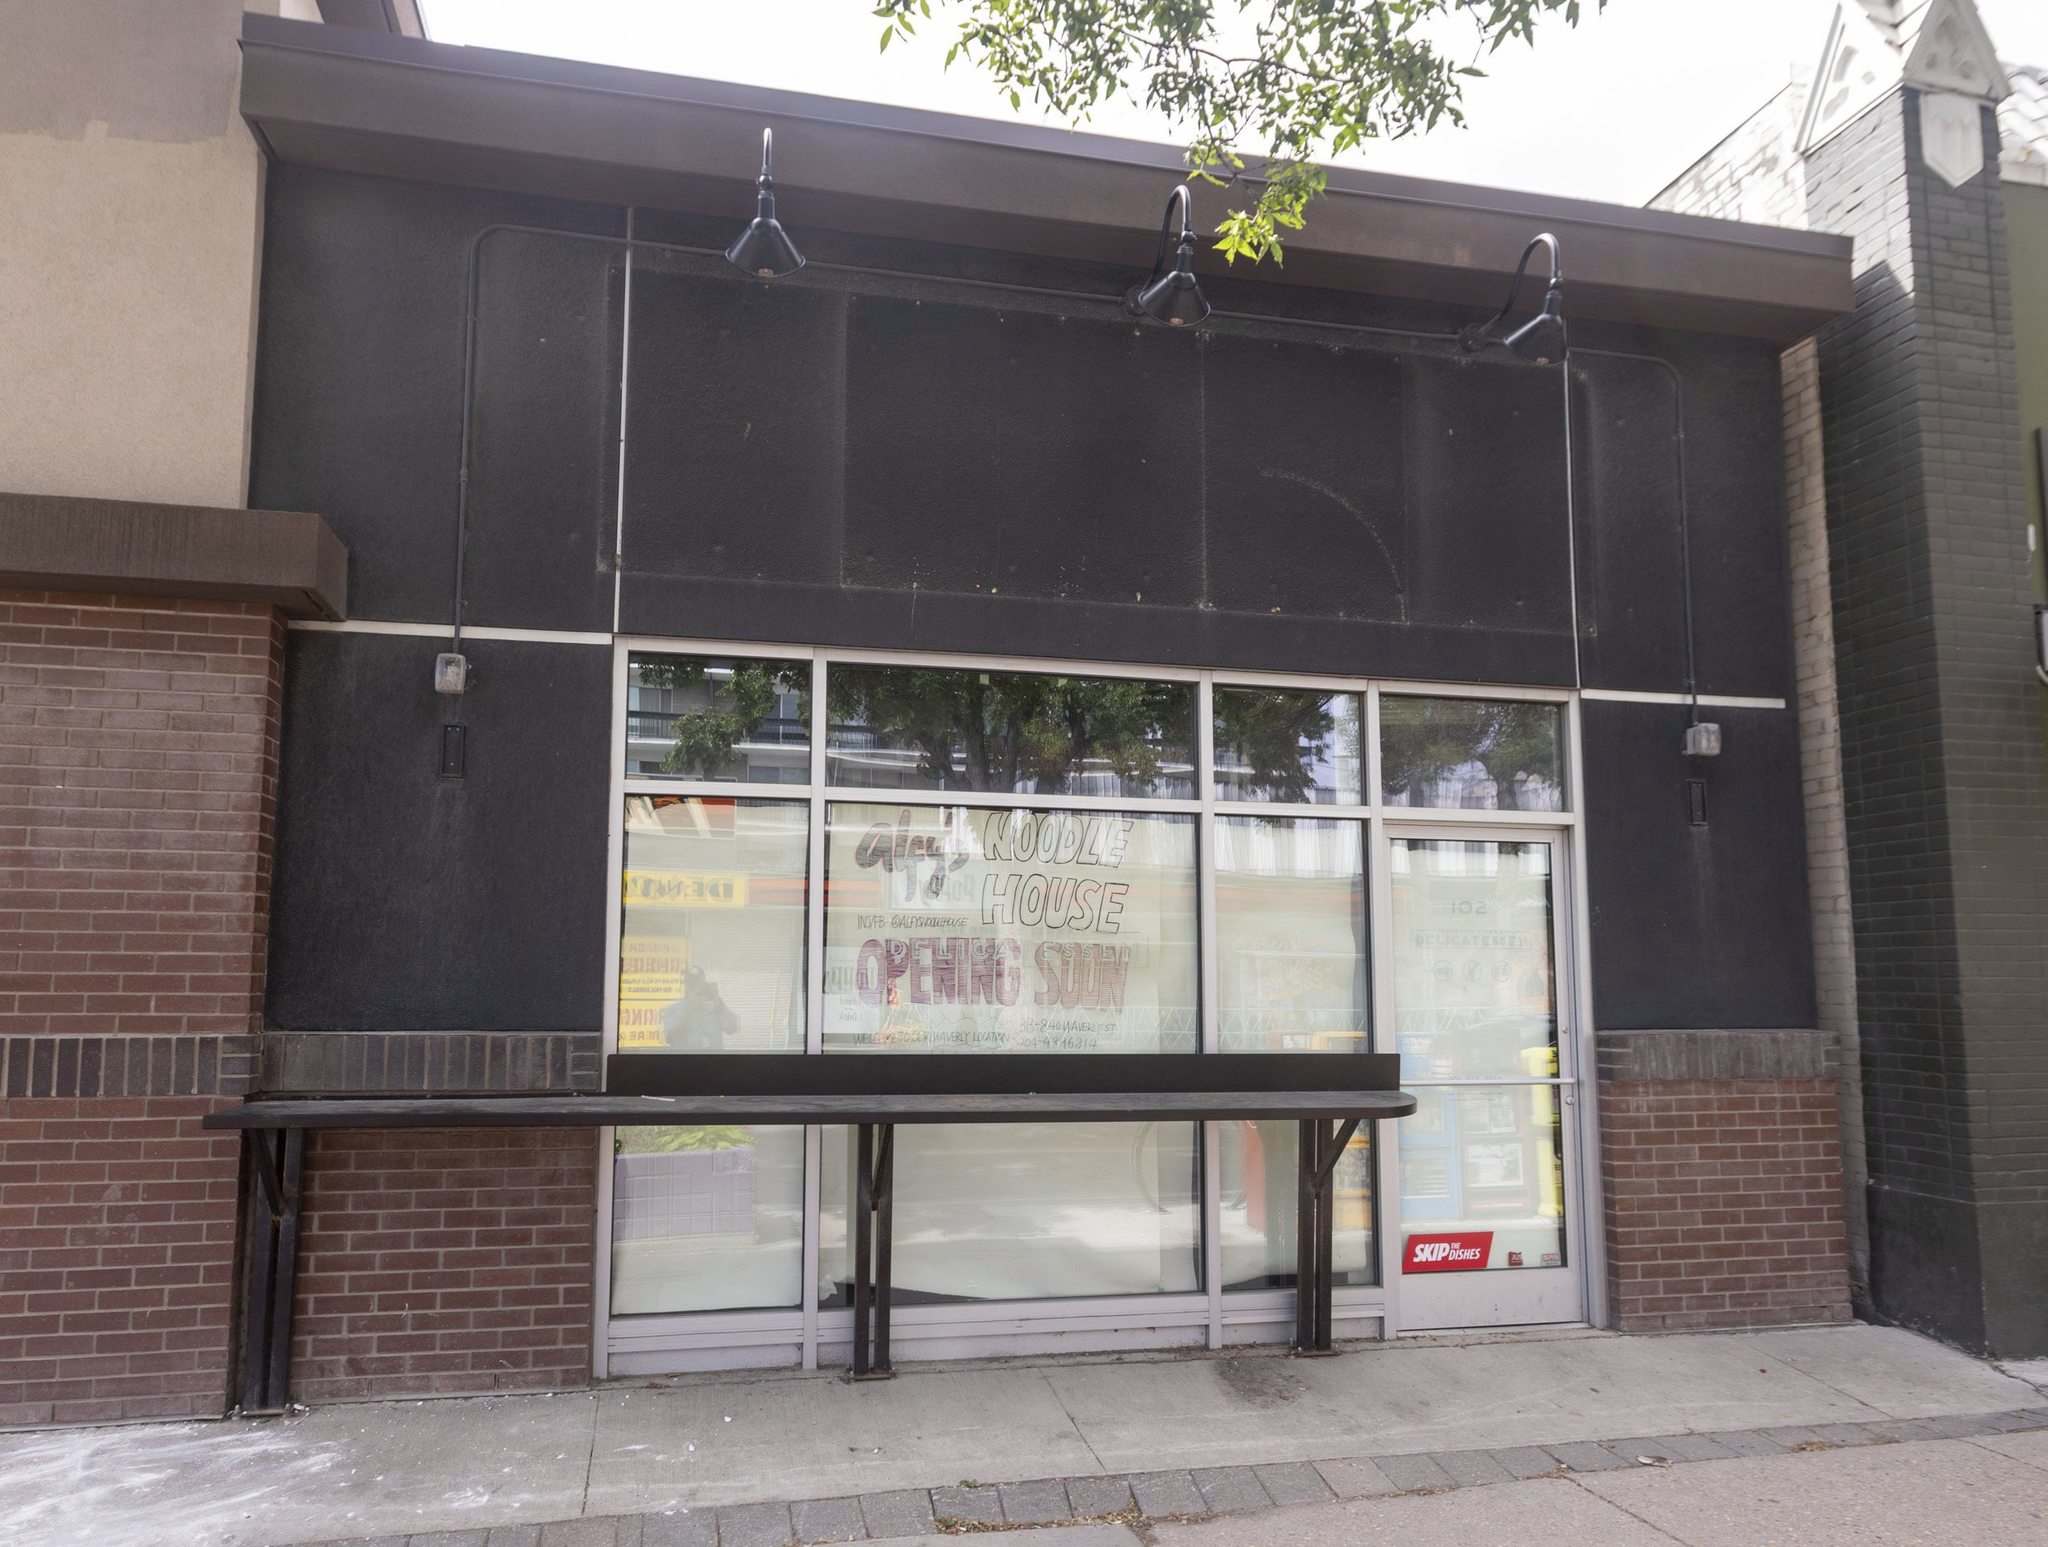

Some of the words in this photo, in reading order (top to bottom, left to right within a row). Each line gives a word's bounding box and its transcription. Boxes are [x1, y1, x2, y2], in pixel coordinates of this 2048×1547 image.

[983, 812, 1134, 868] NOODLE
[981, 873, 1130, 934] HOUSE
[856, 938, 1022, 1007] OPENING
[1034, 942, 1131, 1013] SOON
[1413, 1243, 1449, 1262] SKIP
[1448, 1248, 1481, 1261] DISHES
